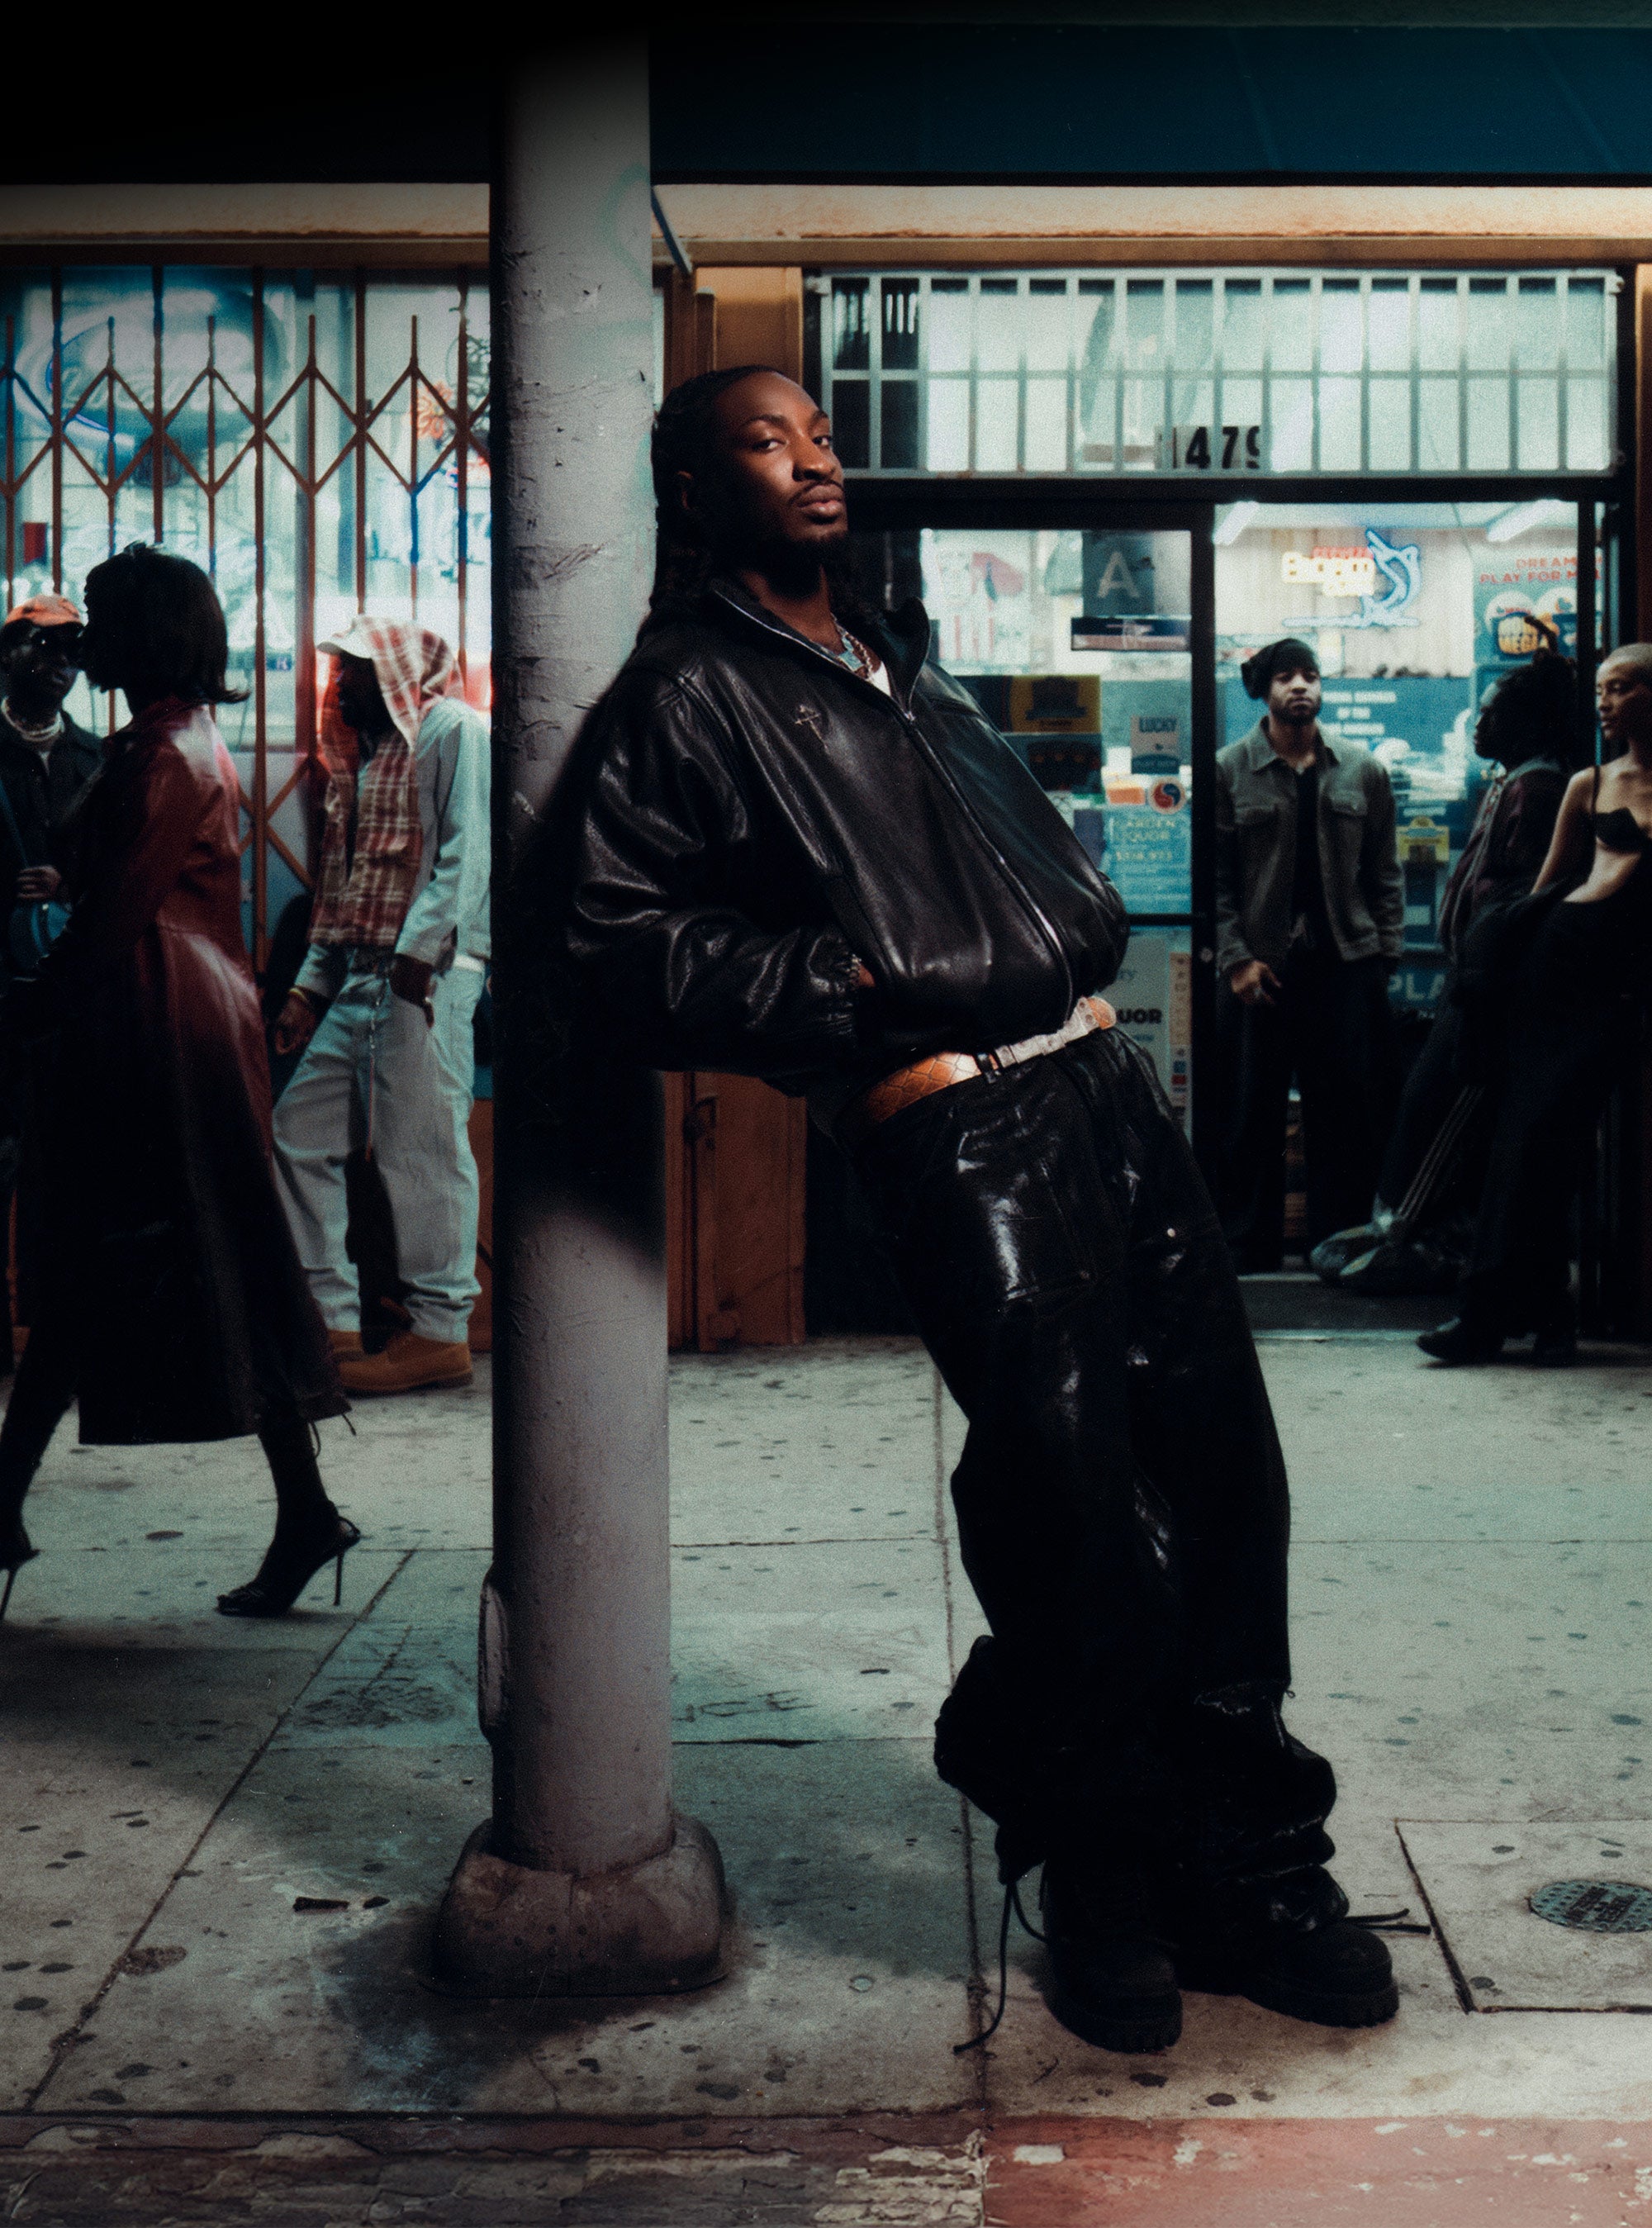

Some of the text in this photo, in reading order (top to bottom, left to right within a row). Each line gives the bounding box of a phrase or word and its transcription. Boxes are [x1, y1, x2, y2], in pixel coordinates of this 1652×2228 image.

[1096, 551, 1140, 598] A
[1479, 573, 1521, 585] PLAY
[1527, 570, 1561, 582] FOR
[1138, 718, 1177, 733] LUCKY
[1116, 1009, 1163, 1024] UOR
